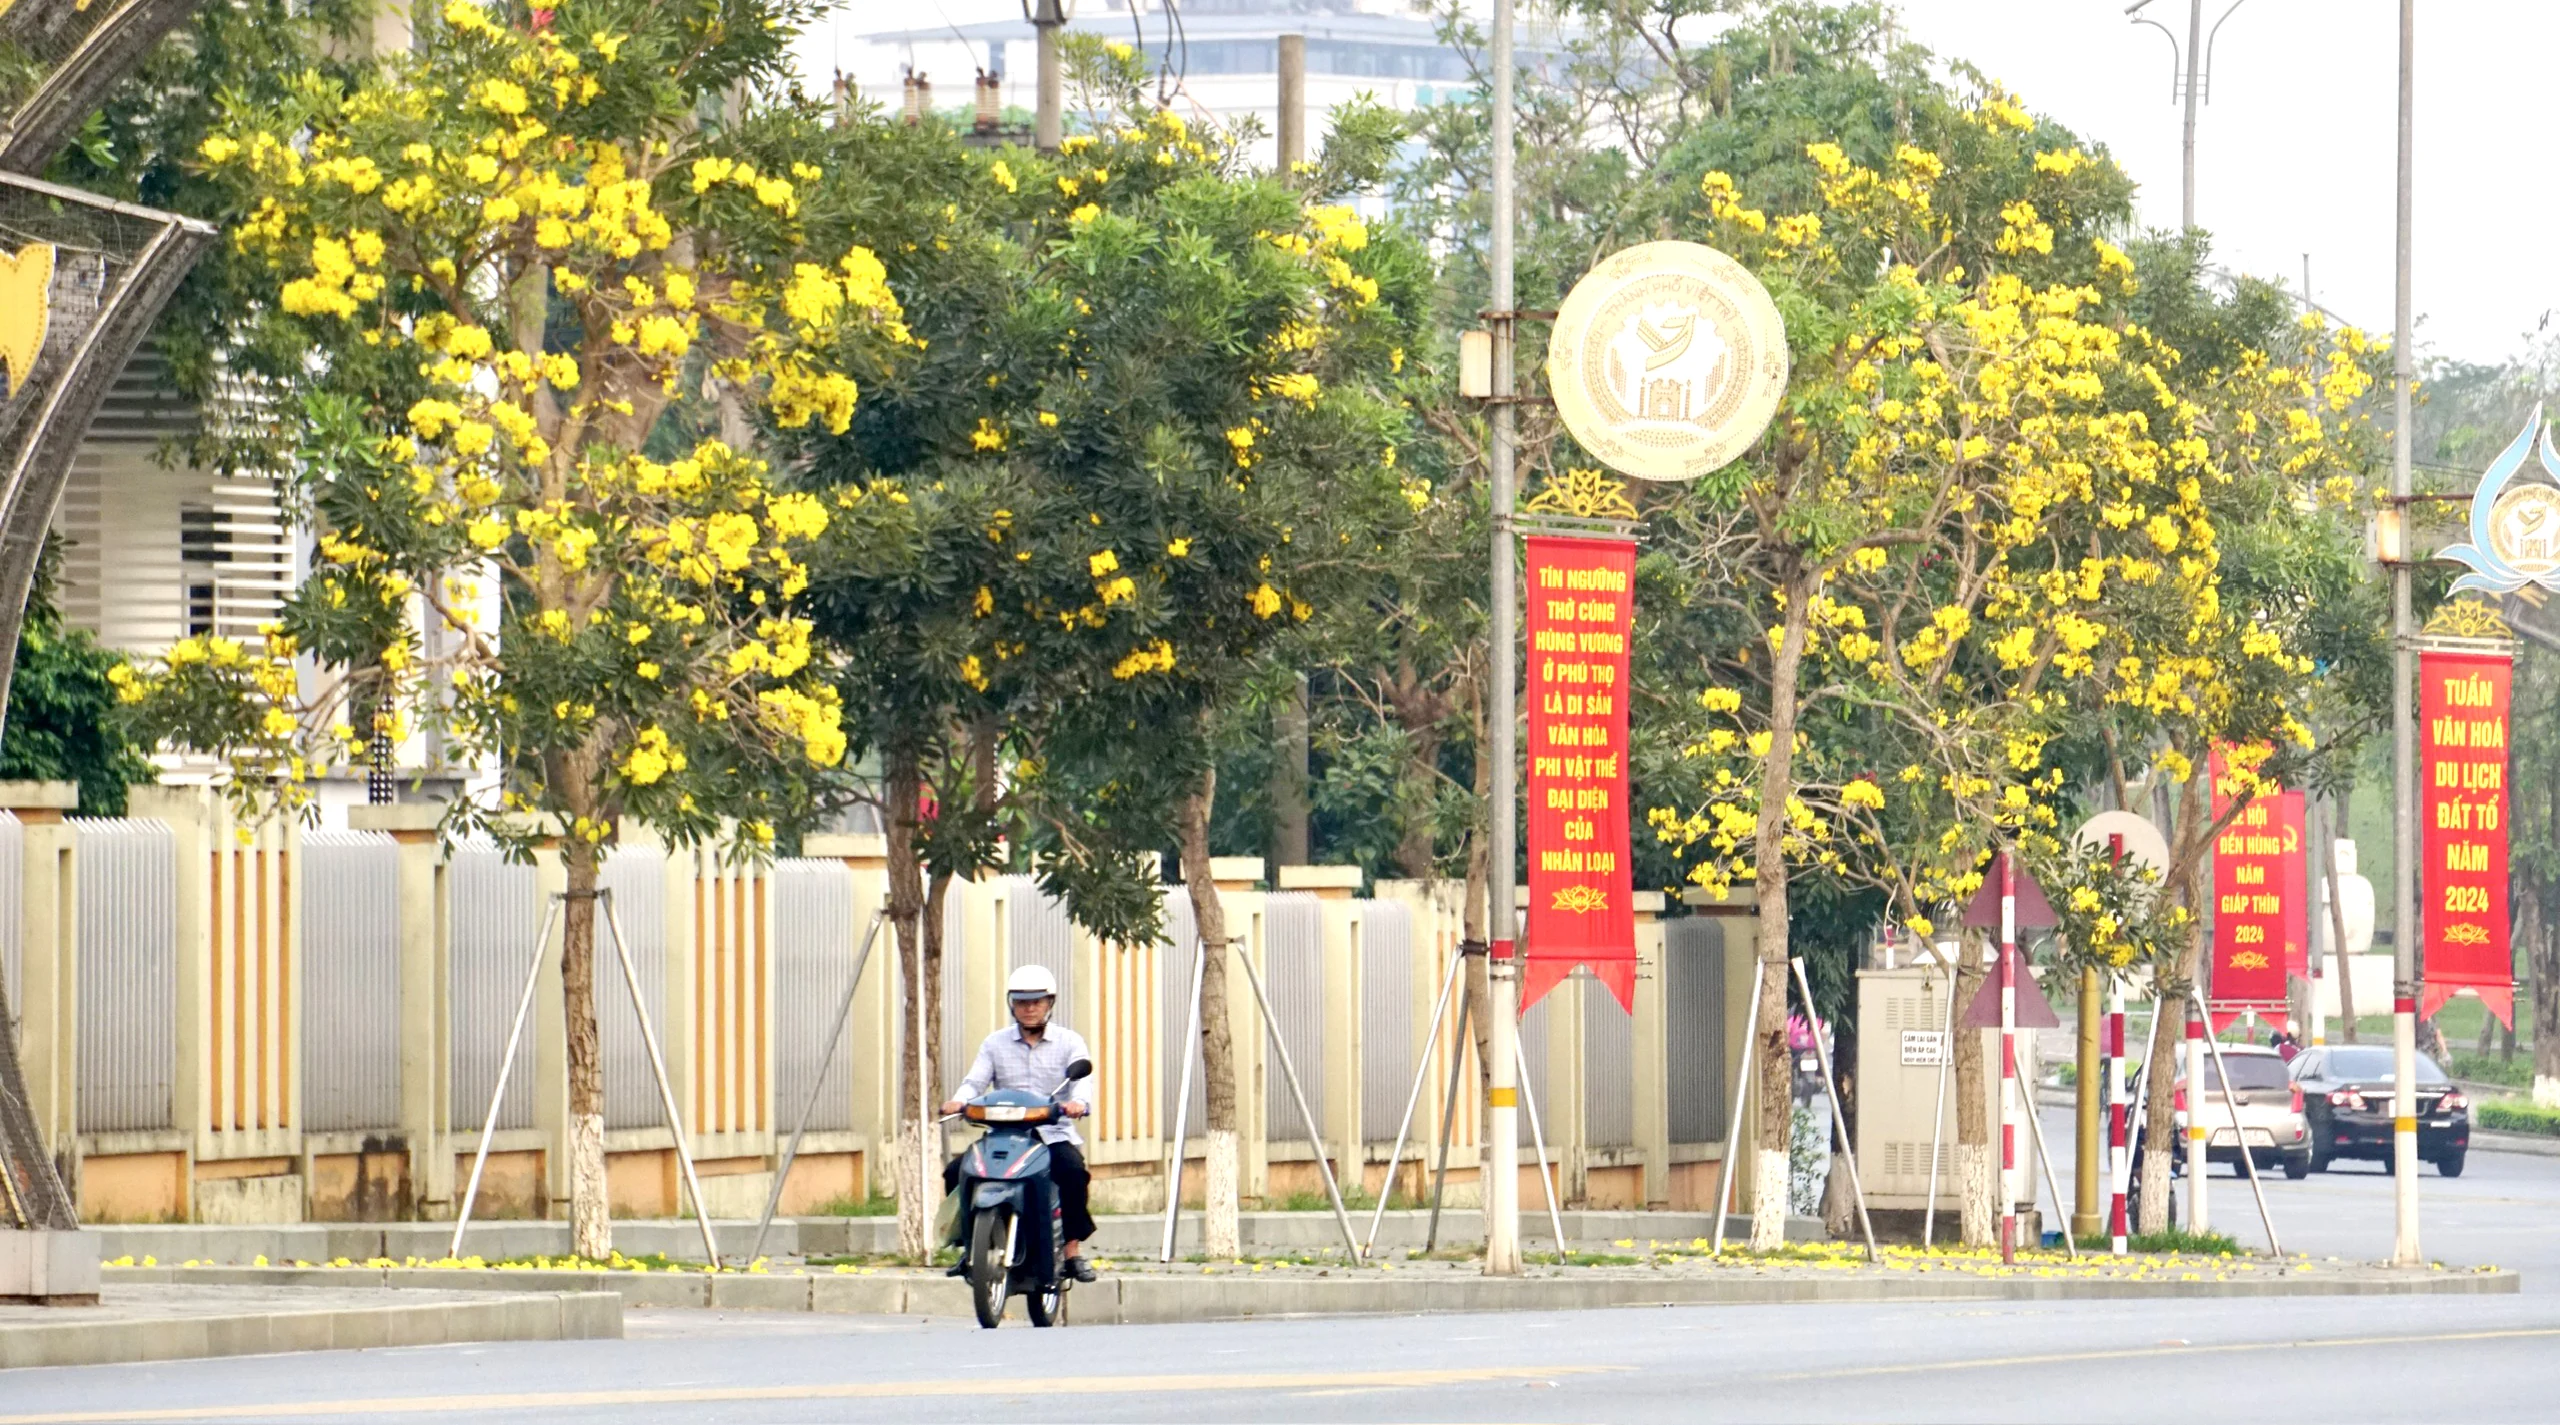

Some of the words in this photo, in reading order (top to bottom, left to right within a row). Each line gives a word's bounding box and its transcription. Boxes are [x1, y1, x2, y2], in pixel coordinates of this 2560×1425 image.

[1604, 286, 1649, 316] THÀNH
[1652, 276, 1682, 293] PHỐ
[1539, 565, 1563, 588] TÍN
[1567, 566, 1626, 592] NGƯỠNG
[1547, 597, 1575, 621] THỜ
[1578, 598, 1615, 622] CÚNG
[1536, 627, 1575, 652] HÙNG
[1579, 631, 1623, 654] VƯƠNG
[1543, 657, 1554, 683] Ở
[1557, 661, 1588, 683] PHÚ
[1592, 665, 1615, 688] THỌ
[1544, 690, 1563, 715] LÀ
[1567, 693, 1583, 715] DI
[1586, 690, 1612, 715] SẢN
[2444, 672, 2493, 707] TUẦN
[1548, 722, 1579, 746] VĂN
[1582, 724, 1608, 746] HÓA
[2432, 715, 2466, 747] VĂN
[2470, 716, 2504, 748] HOÁ
[1535, 756, 1561, 777] PHI
[1565, 754, 1593, 782] VẬT
[1595, 750, 1618, 778] THỂ
[2435, 761, 2459, 788] DU
[2463, 762, 2501, 794] LỊCH
[1547, 788, 1574, 813] ĐẠI
[1577, 785, 1608, 813] DIỆN
[2437, 794, 2472, 830] ĐẤT
[2475, 793, 2499, 831] TỔ
[1564, 815, 1594, 840] CỦA
[2246, 803, 2268, 829] HỘI
[2246, 832, 2280, 855] HÙNG
[2447, 839, 2489, 872] NĂM
[1541, 848, 1583, 872] NHÂN
[1586, 851, 1615, 876] LOẠI
[2236, 862, 2265, 885] NĂM
[2221, 892, 2249, 914] GIÁP
[2252, 892, 2280, 915] THÌN
[2445, 885, 2490, 913] 2024
[2234, 925, 2265, 943] 2024
